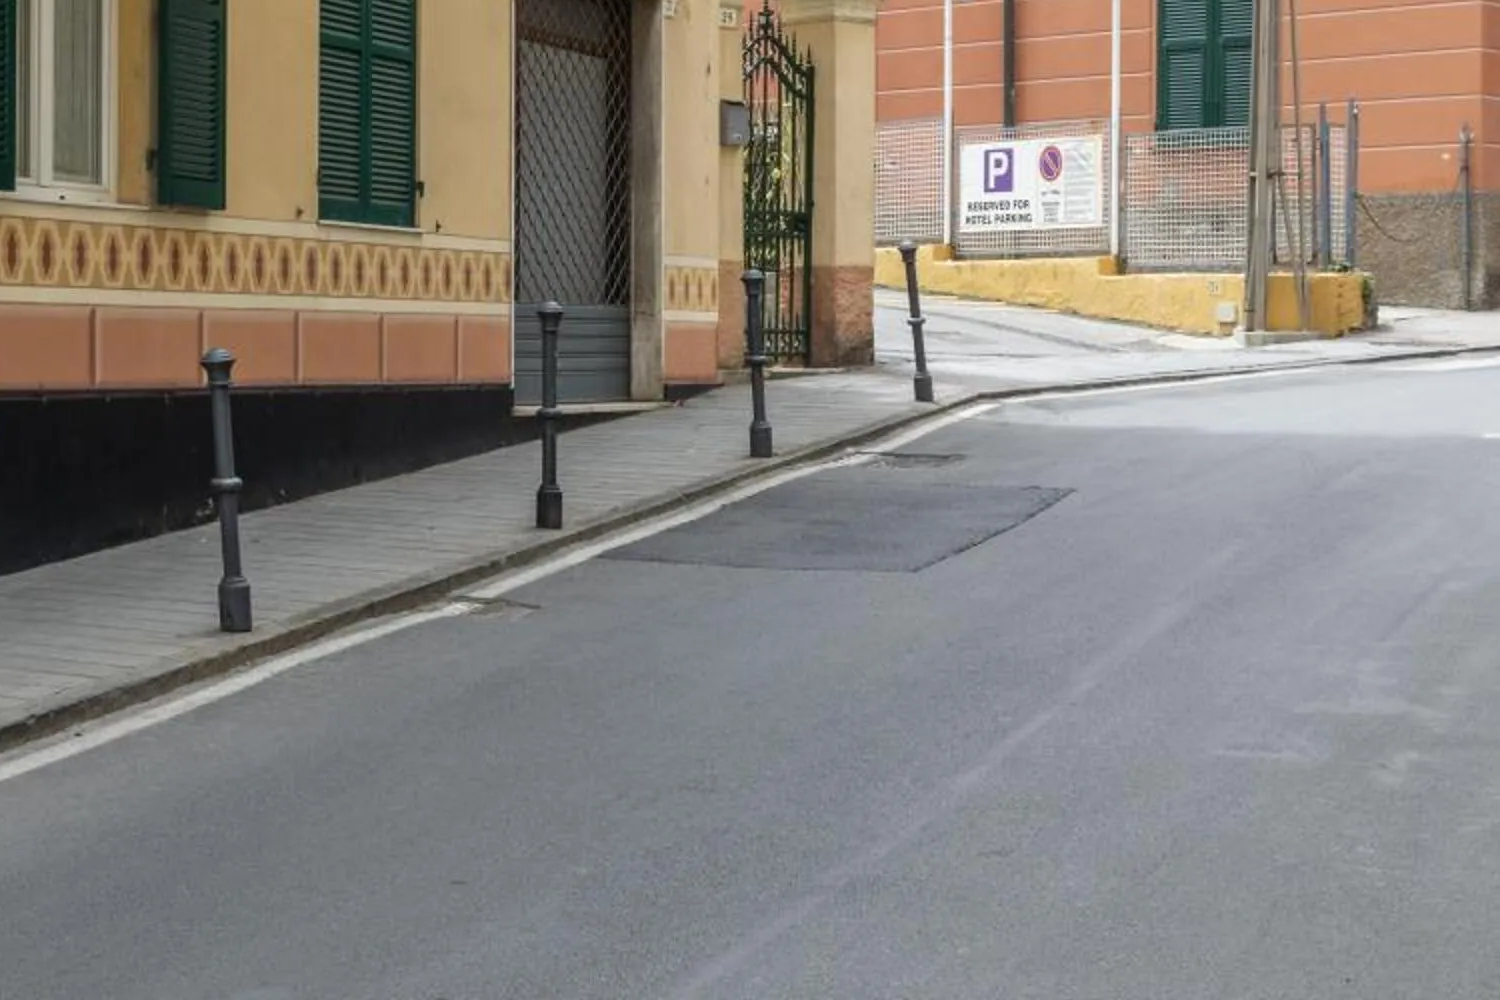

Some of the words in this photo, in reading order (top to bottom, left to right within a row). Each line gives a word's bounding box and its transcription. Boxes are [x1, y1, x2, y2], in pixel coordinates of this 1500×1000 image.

[987, 151, 1009, 189] P
[967, 200, 1011, 212] RESERVED
[1013, 199, 1030, 210] FOR
[965, 214, 992, 225] HOTEL
[994, 213, 1033, 224] PARKING
